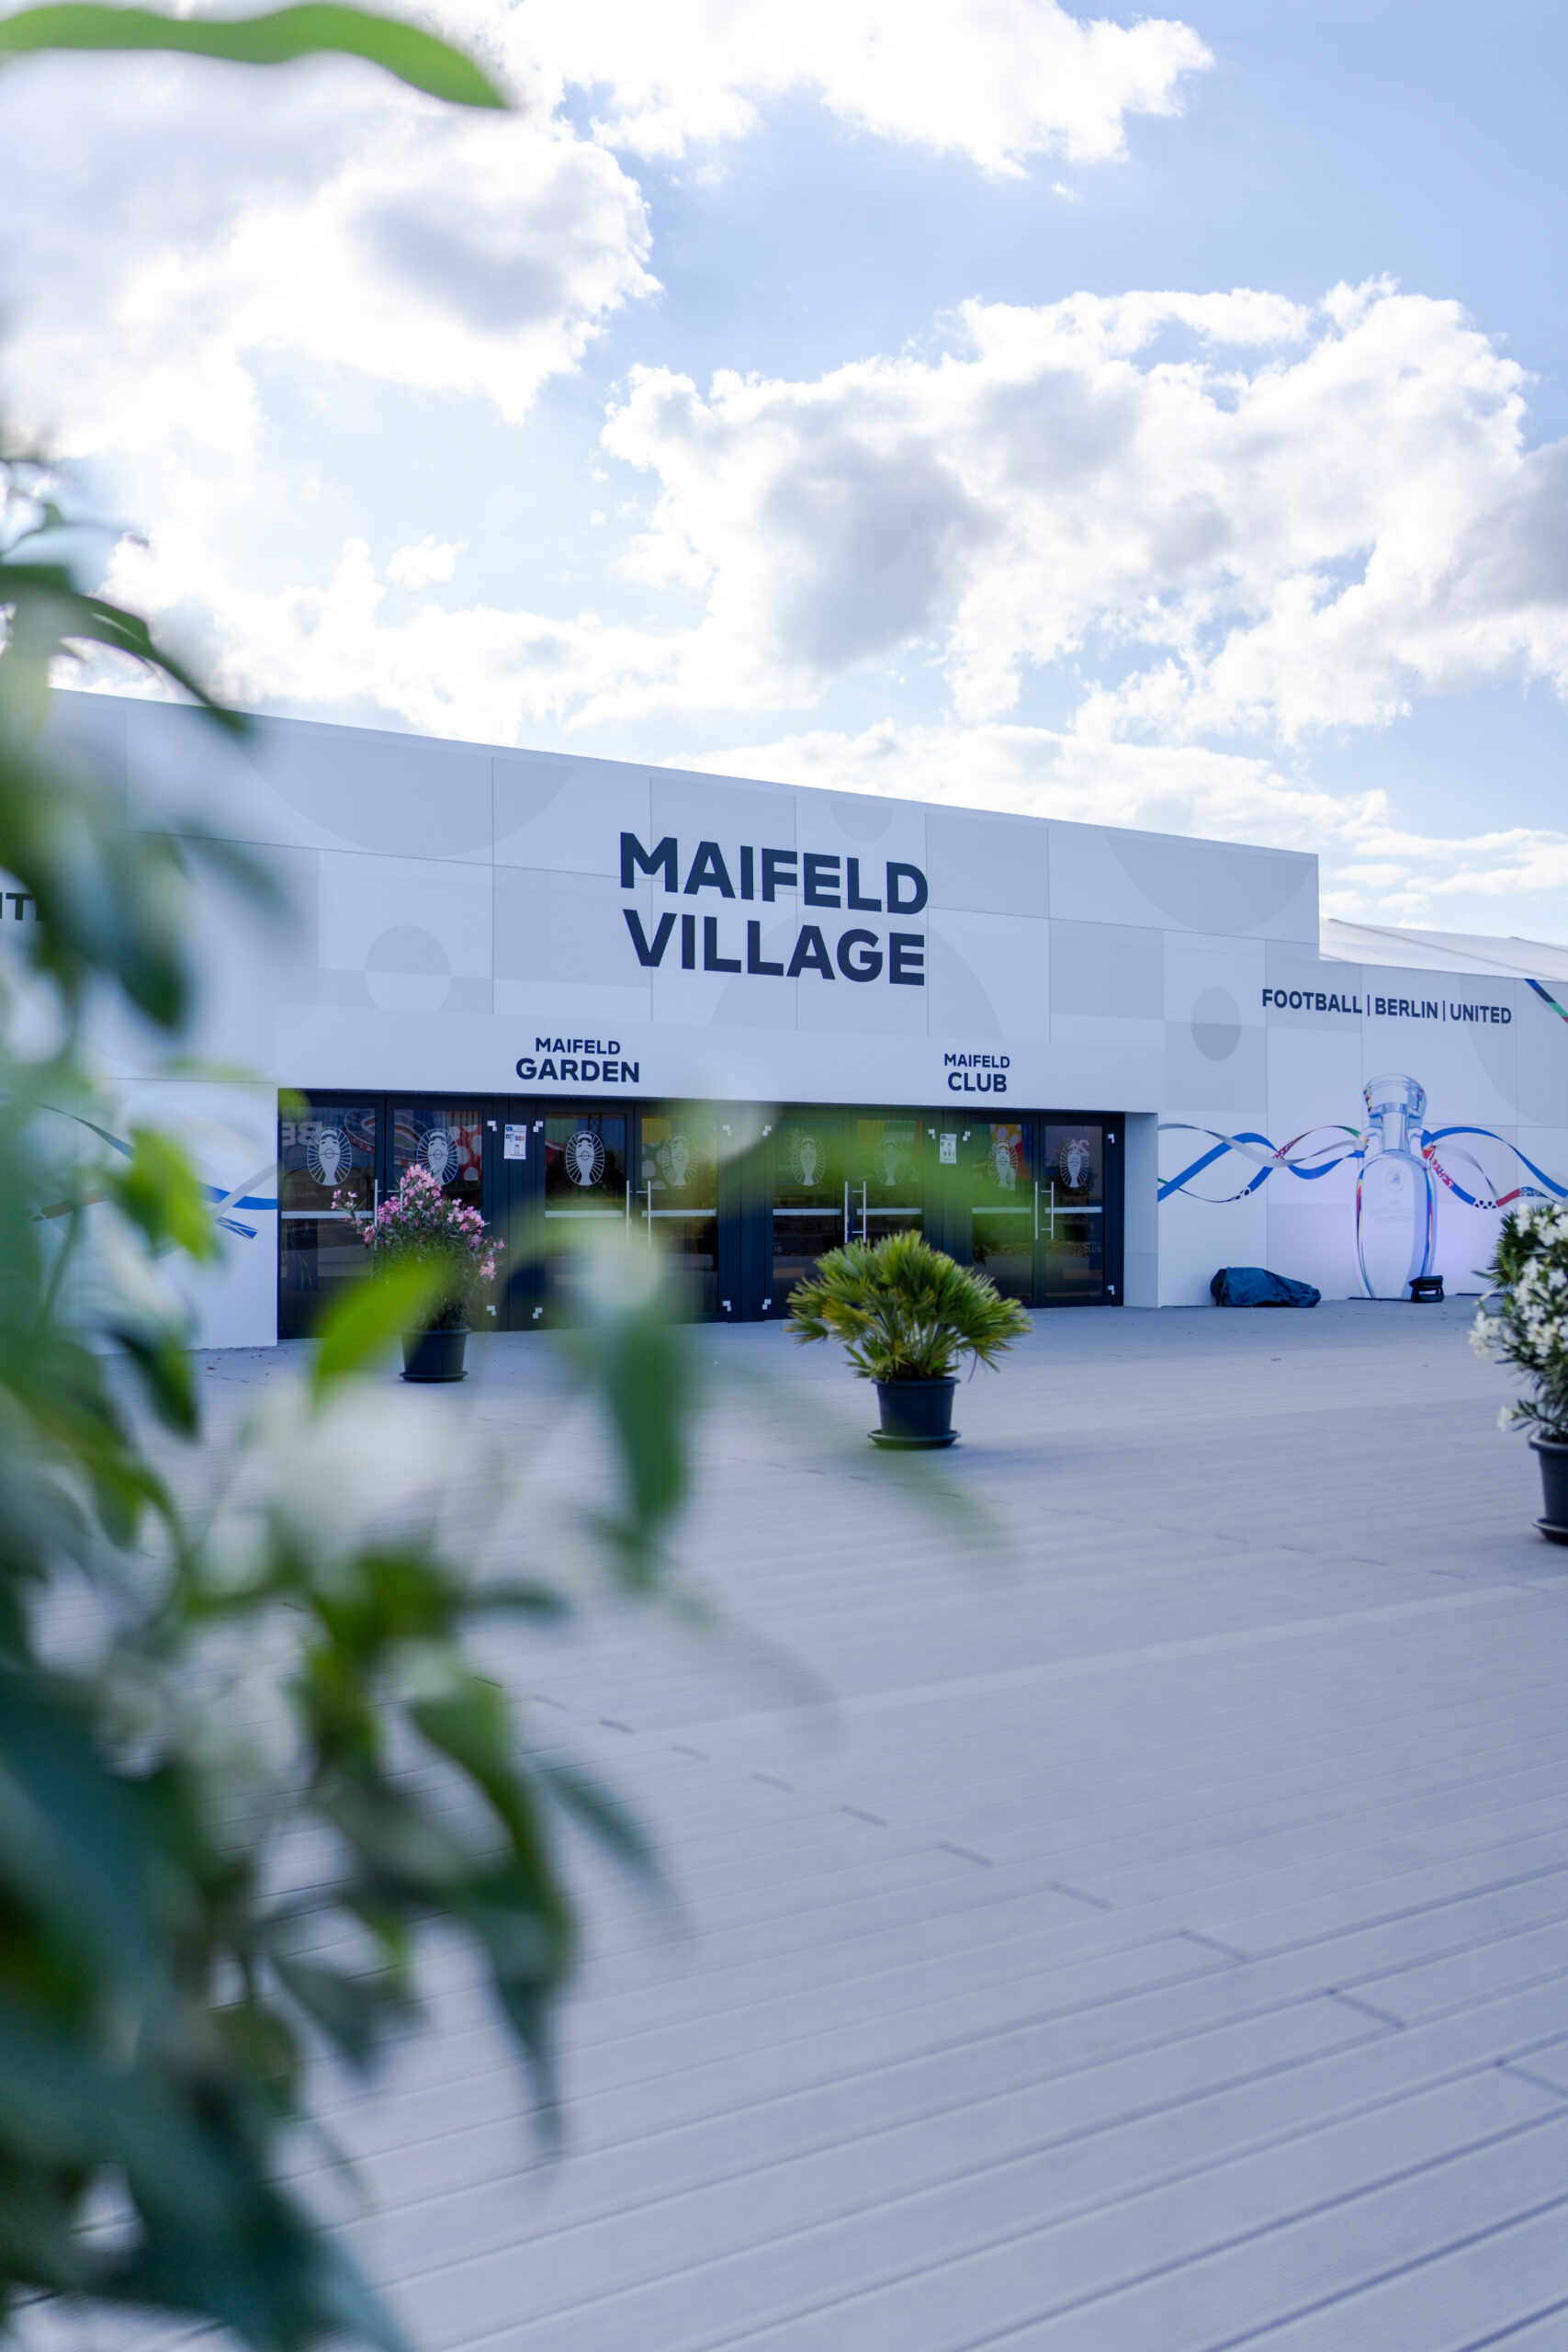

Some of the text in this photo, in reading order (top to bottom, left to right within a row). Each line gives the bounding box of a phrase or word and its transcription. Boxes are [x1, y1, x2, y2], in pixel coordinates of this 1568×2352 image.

[620, 831, 929, 915] MAIFELD
[622, 908, 925, 987] VILLAGE
[1262, 989, 1512, 1024] FOOTBALL BERLIN UNITED
[536, 1037, 621, 1056] MAIFELD
[515, 1057, 640, 1083] GARDEN
[944, 1053, 1010, 1069] MAIFELD
[947, 1071, 1008, 1093] CLUB
